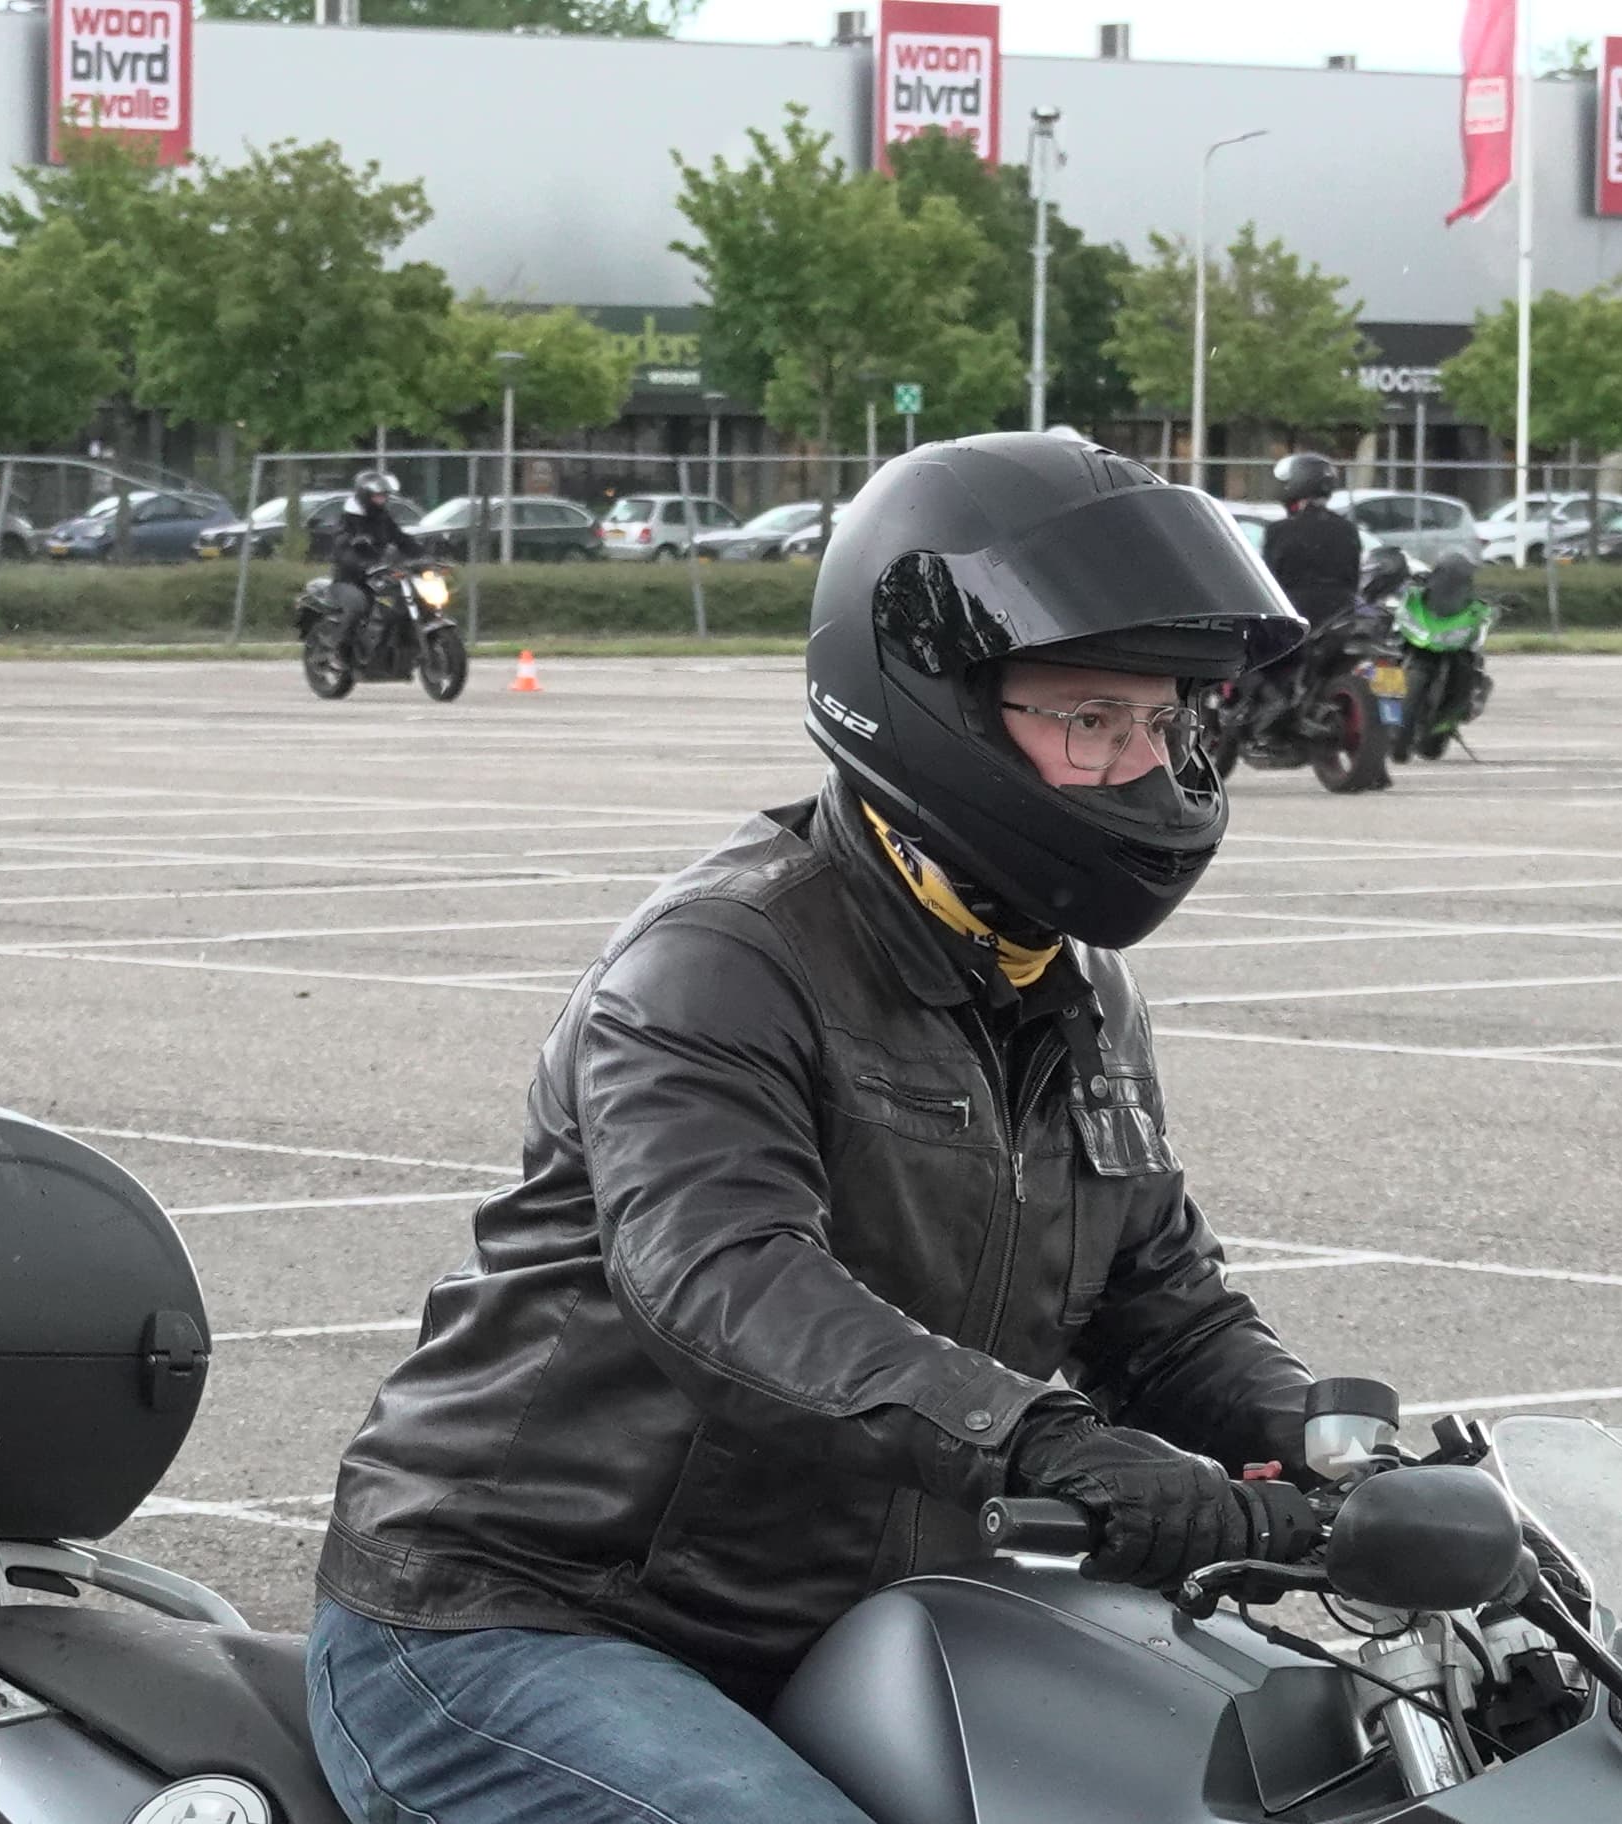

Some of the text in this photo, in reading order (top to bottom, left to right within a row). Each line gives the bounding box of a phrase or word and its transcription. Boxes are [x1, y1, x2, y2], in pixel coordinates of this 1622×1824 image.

[71, 8, 169, 38] woon
[71, 40, 169, 84] blvrd
[895, 45, 981, 73] woon
[895, 74, 981, 116] blvrd
[810, 680, 879, 741] LS2
